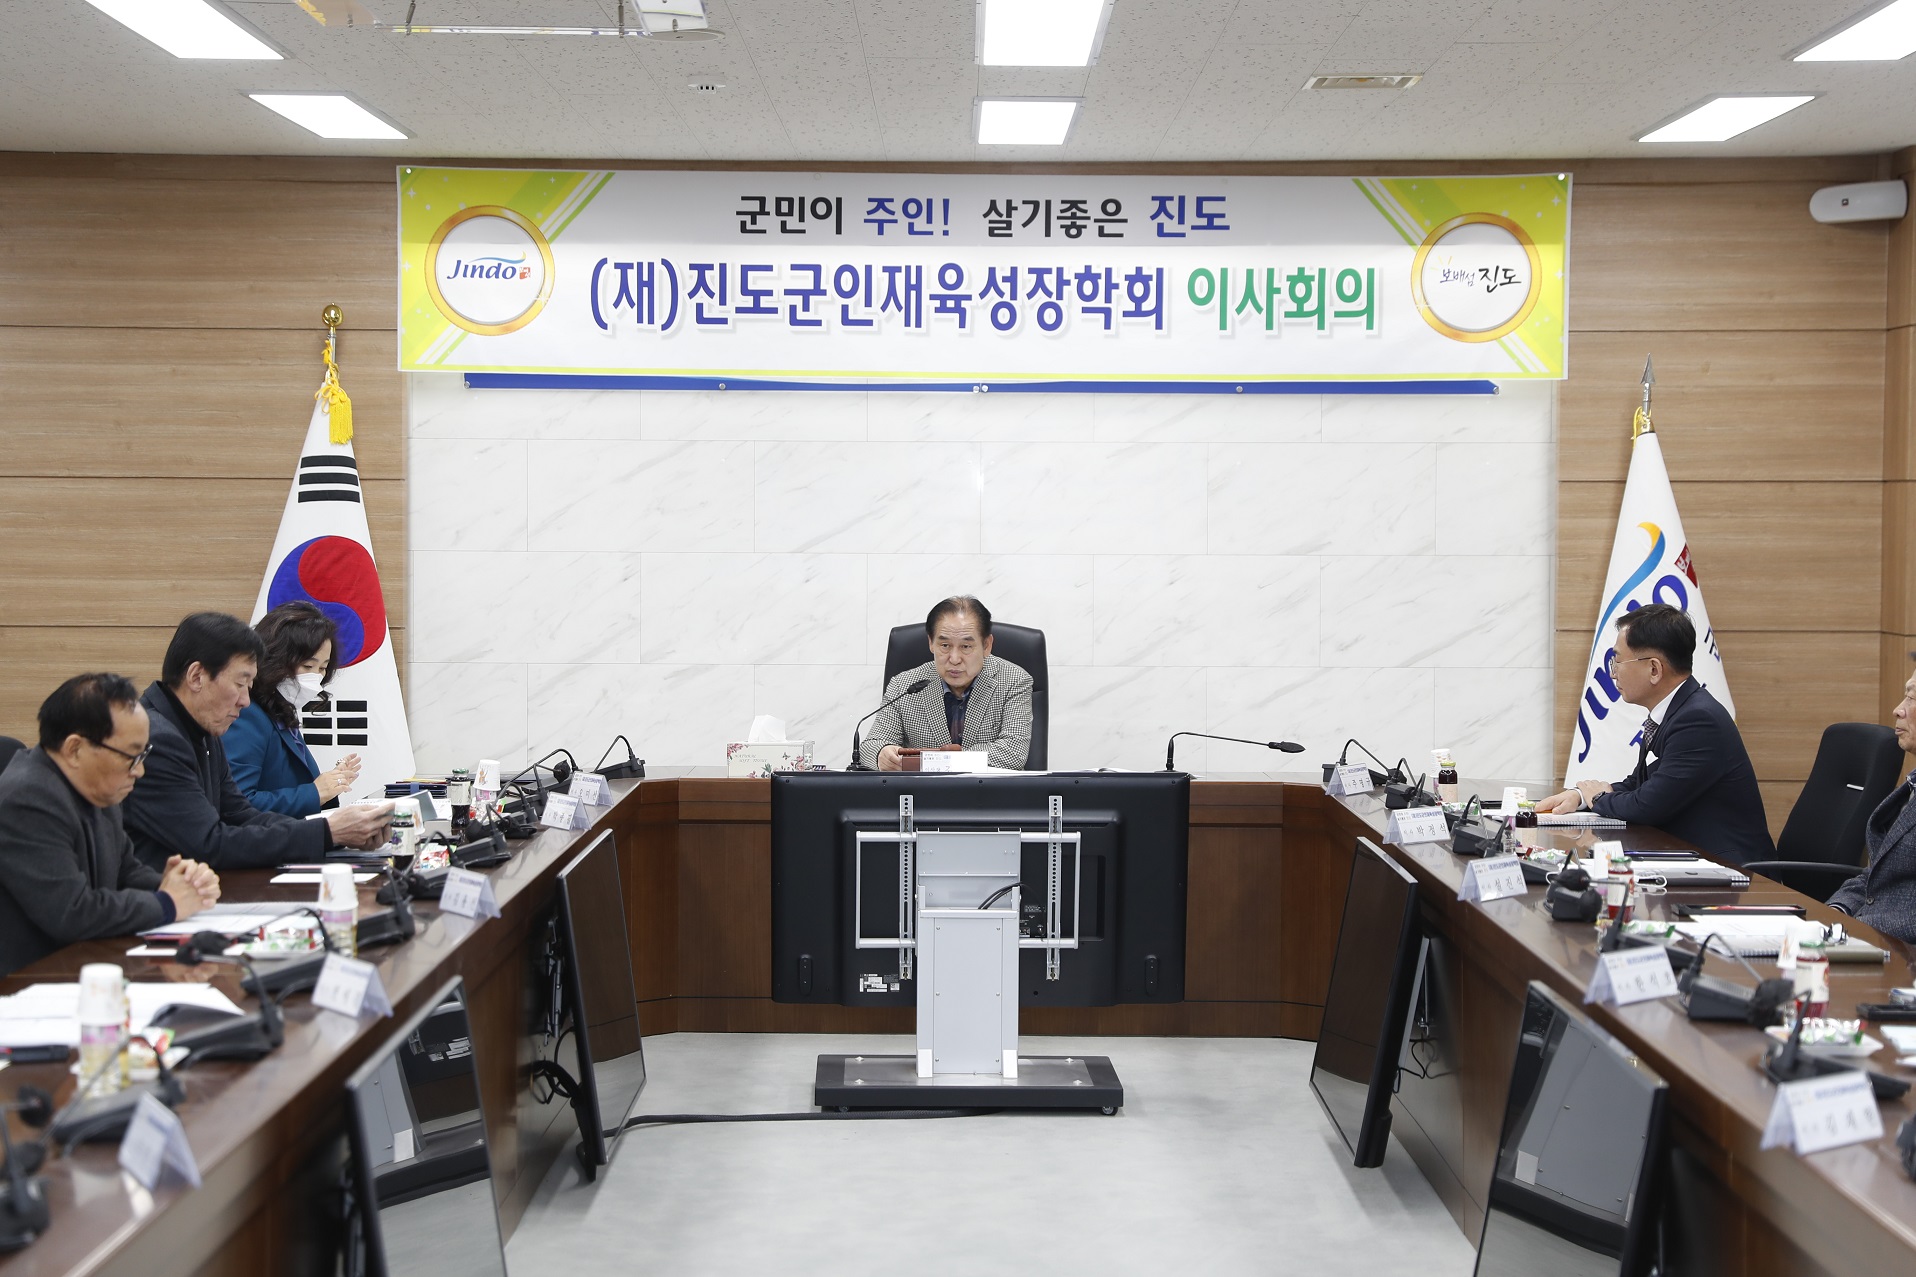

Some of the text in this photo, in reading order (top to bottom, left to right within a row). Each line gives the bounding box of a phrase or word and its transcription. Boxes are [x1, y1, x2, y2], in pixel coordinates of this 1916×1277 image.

[735, 195, 1231, 239] 군민이 주인! 살기좋은 진도
[446, 259, 517, 280] Jindo
[1440, 265, 1522, 293] 보배섬 진도
[590, 257, 1375, 332] (재)진도군인재육성장학회 이사회의
